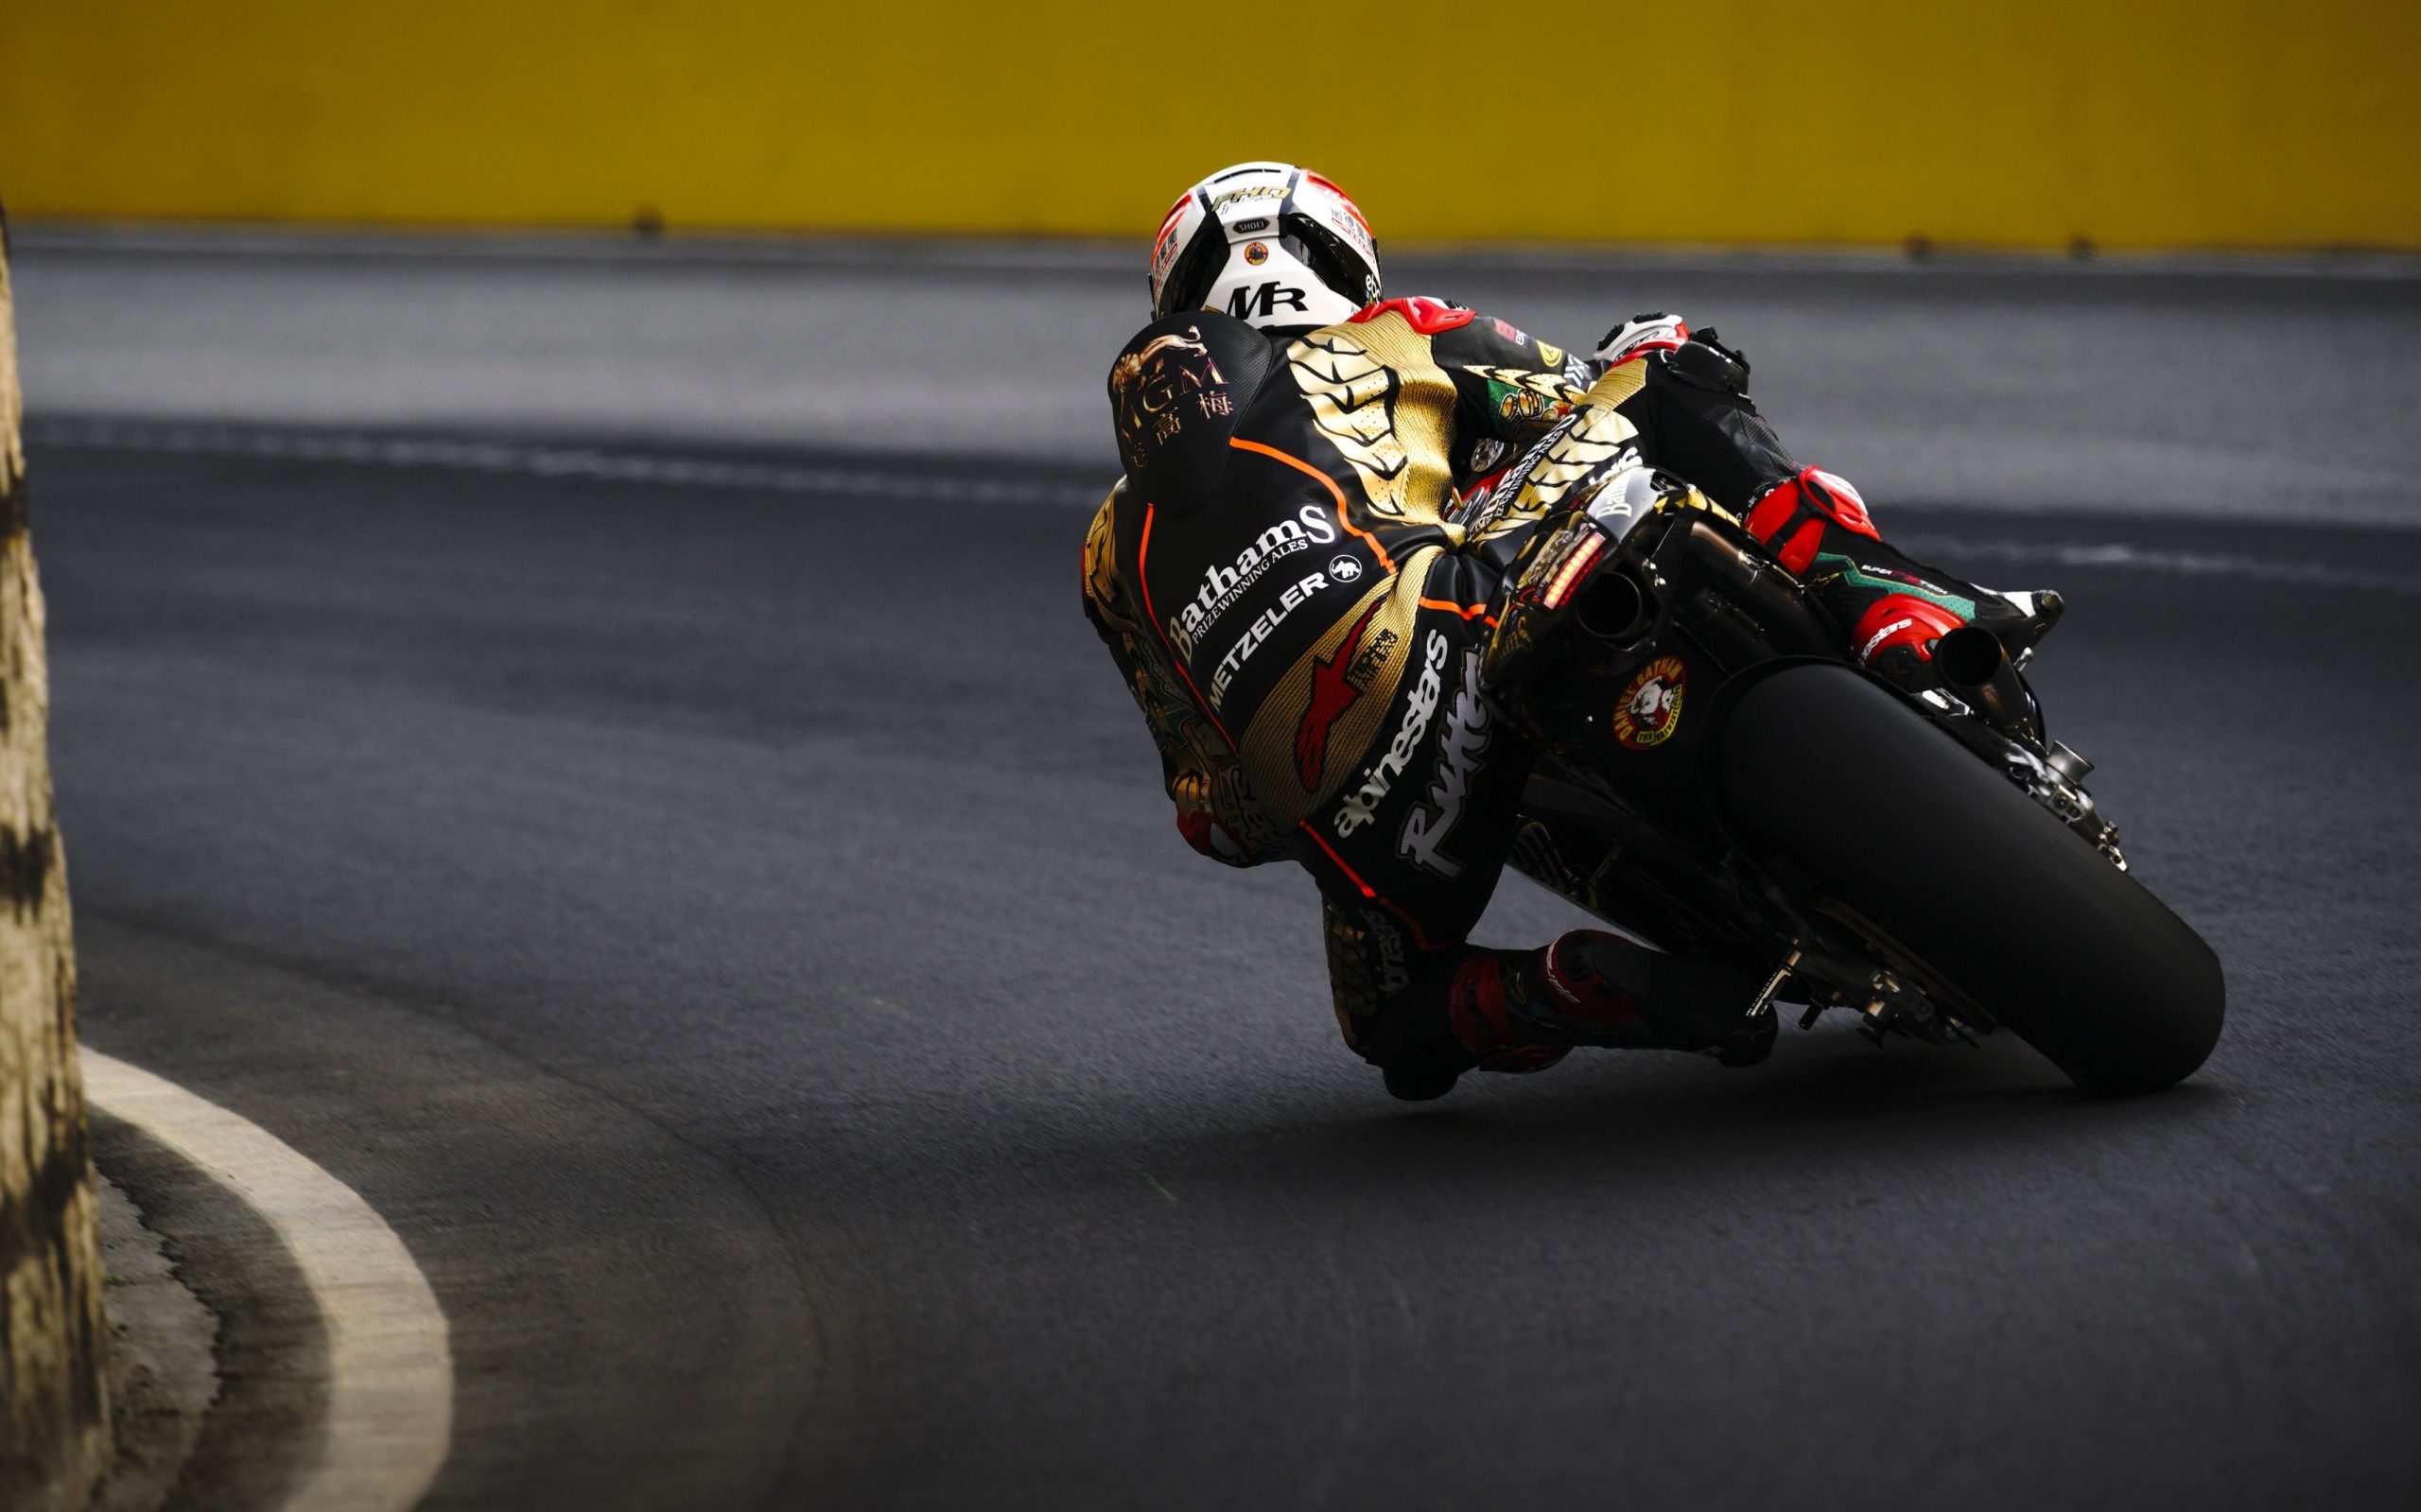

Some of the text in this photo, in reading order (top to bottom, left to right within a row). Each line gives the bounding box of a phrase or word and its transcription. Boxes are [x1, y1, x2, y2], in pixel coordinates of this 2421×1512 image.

[1239, 221, 1264, 232] SHOEI
[1228, 281, 1309, 320] MR
[1192, 539, 1308, 645] PRIZEWINNING ALES
[1209, 571, 1329, 712] METZELER
[1333, 629, 1448, 839] alpinestars
